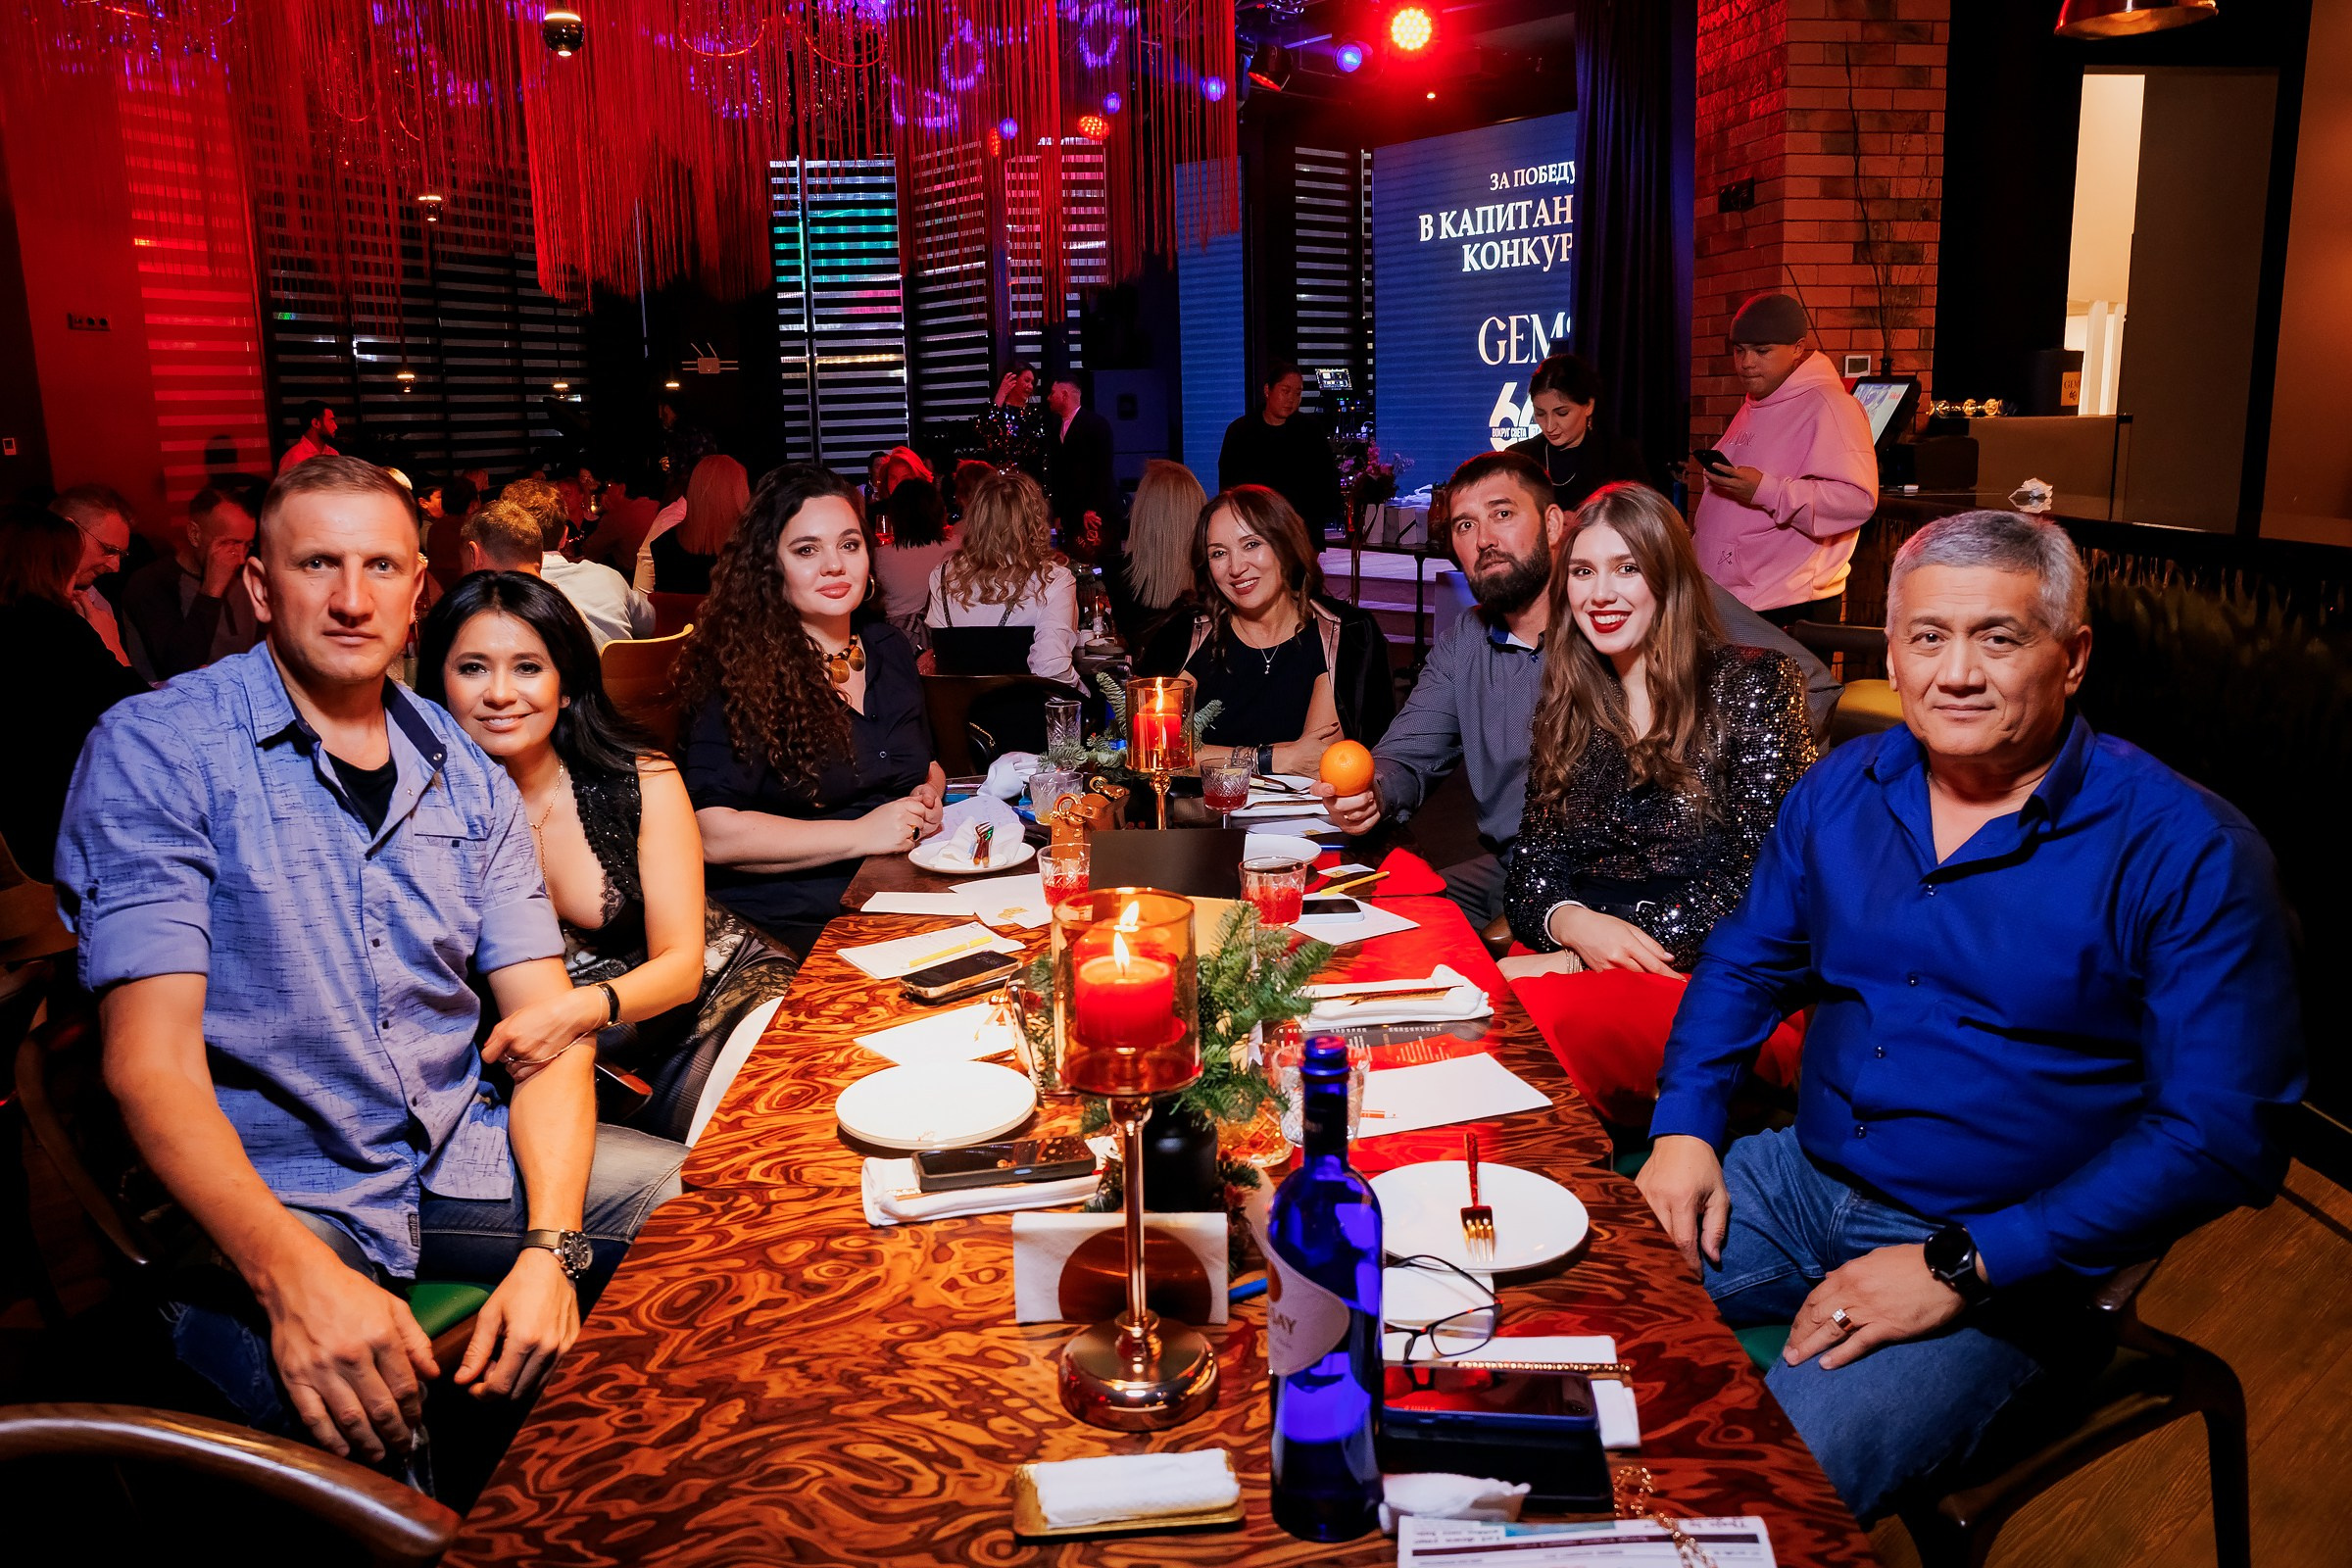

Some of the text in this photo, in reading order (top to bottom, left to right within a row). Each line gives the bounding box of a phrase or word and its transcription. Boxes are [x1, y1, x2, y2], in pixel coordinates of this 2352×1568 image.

[1490, 172, 1510, 191] ЗА
[1419, 194, 1573, 242] В КАПИТАН
[1462, 232, 1573, 272] КОНКУР
[1478, 311, 1570, 366] GEM
